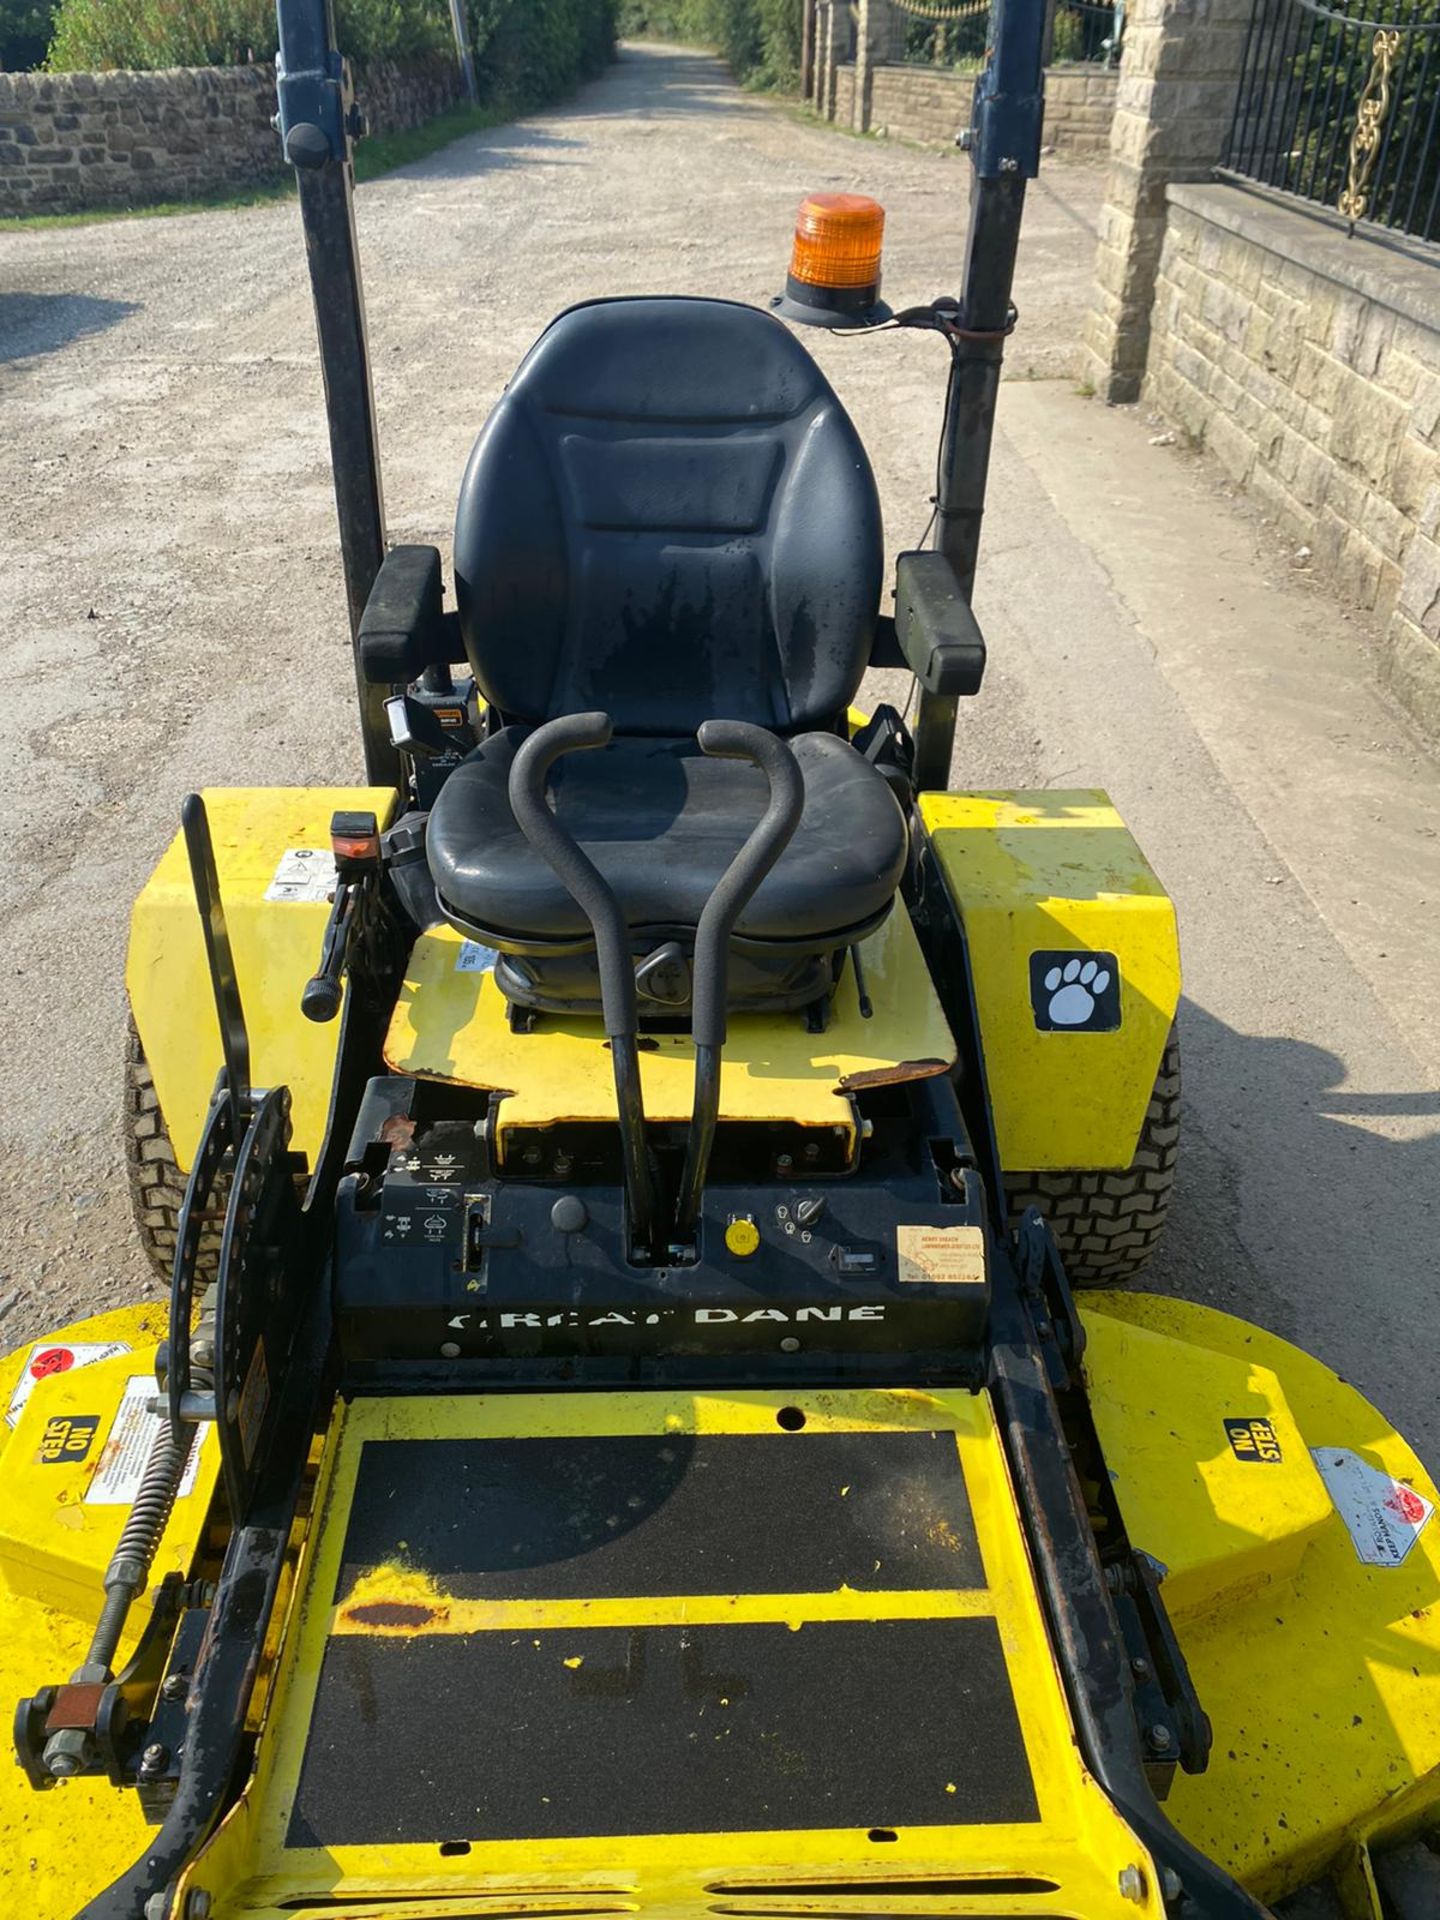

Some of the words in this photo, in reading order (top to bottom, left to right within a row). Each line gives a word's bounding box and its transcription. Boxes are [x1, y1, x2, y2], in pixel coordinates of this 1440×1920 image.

[695, 1305, 886, 1324] DANE
[44, 1420, 72, 1459] STEP
[68, 1427, 93, 1451] NO
[1229, 1427, 1256, 1451] NO
[1248, 1420, 1281, 1459] STEP
[1372, 1507, 1392, 1537] HANDS
[1385, 1537, 1402, 1560] KEEP
